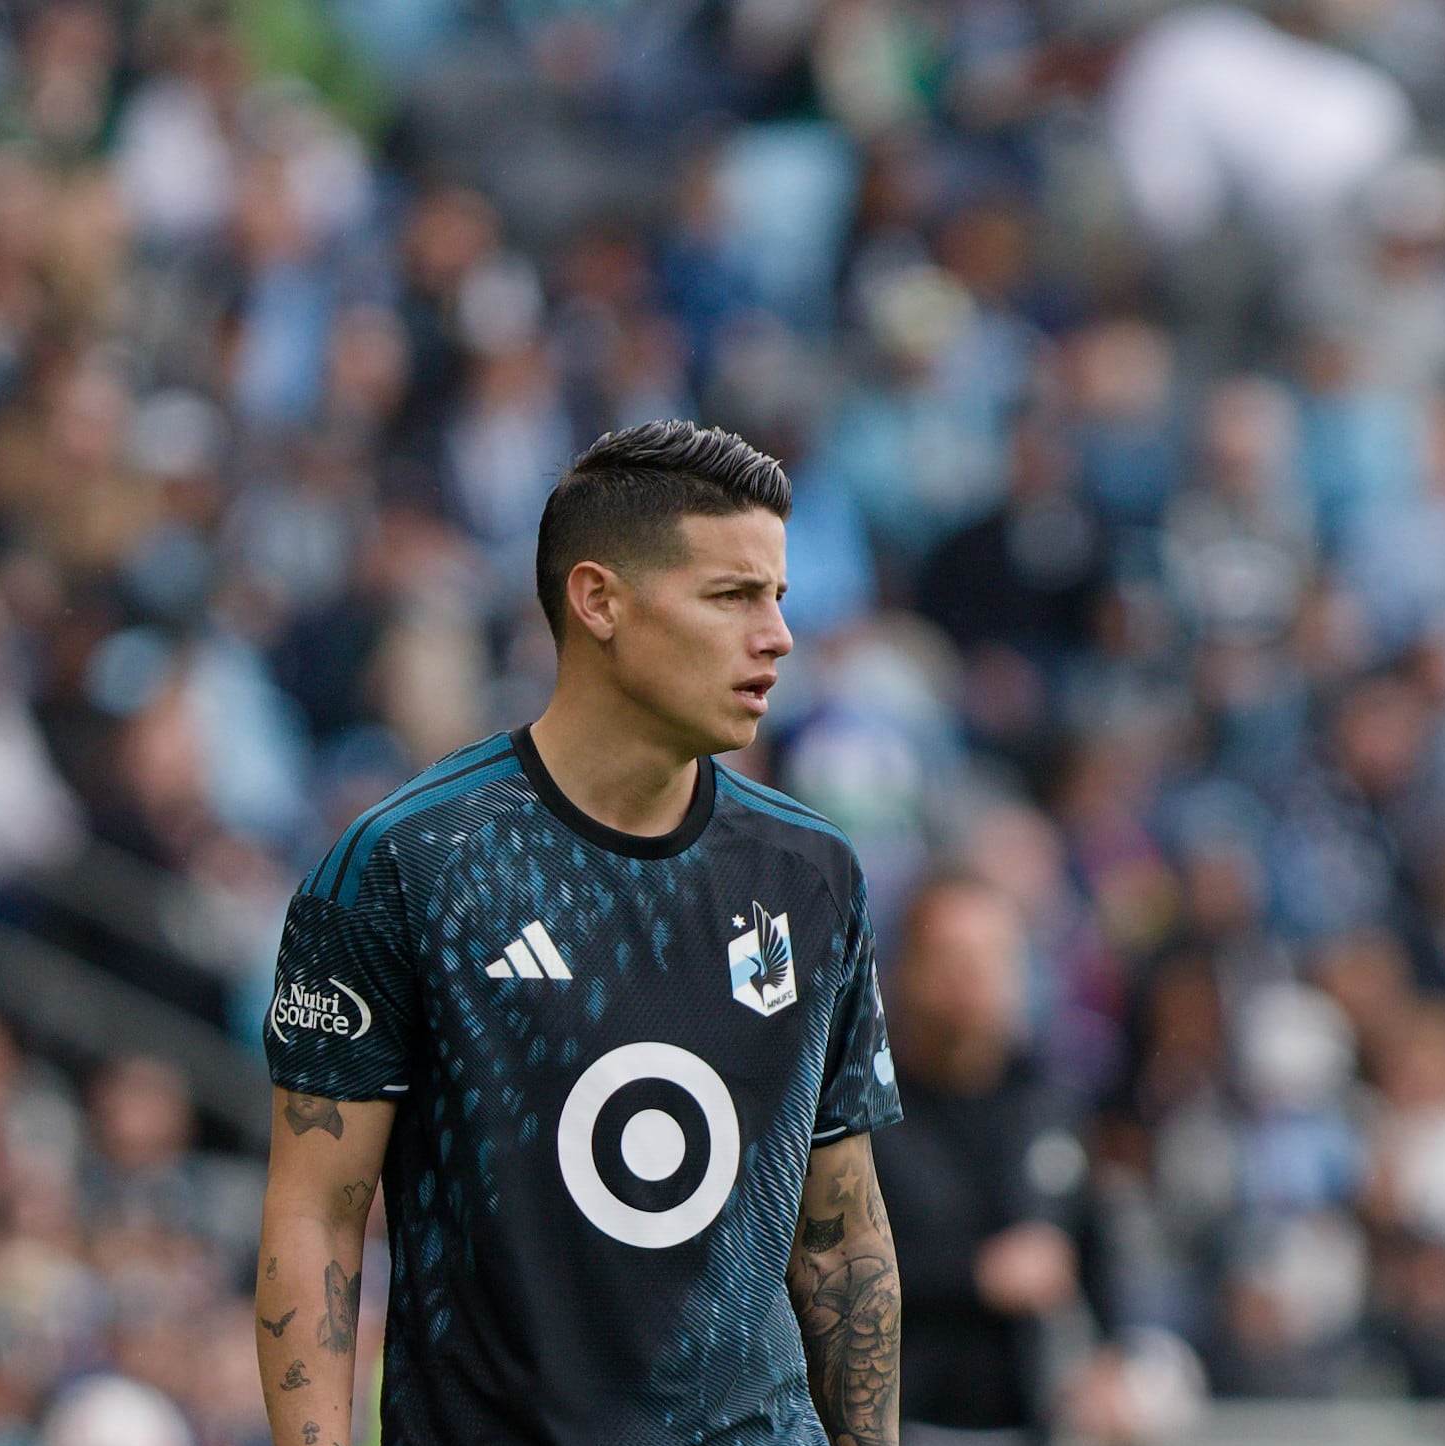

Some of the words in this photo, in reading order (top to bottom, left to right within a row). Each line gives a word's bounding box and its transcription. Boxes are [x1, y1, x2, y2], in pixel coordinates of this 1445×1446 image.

[288, 983, 340, 1014] Nutri
[766, 989, 794, 1011] MNUFC
[276, 998, 349, 1035] Source
